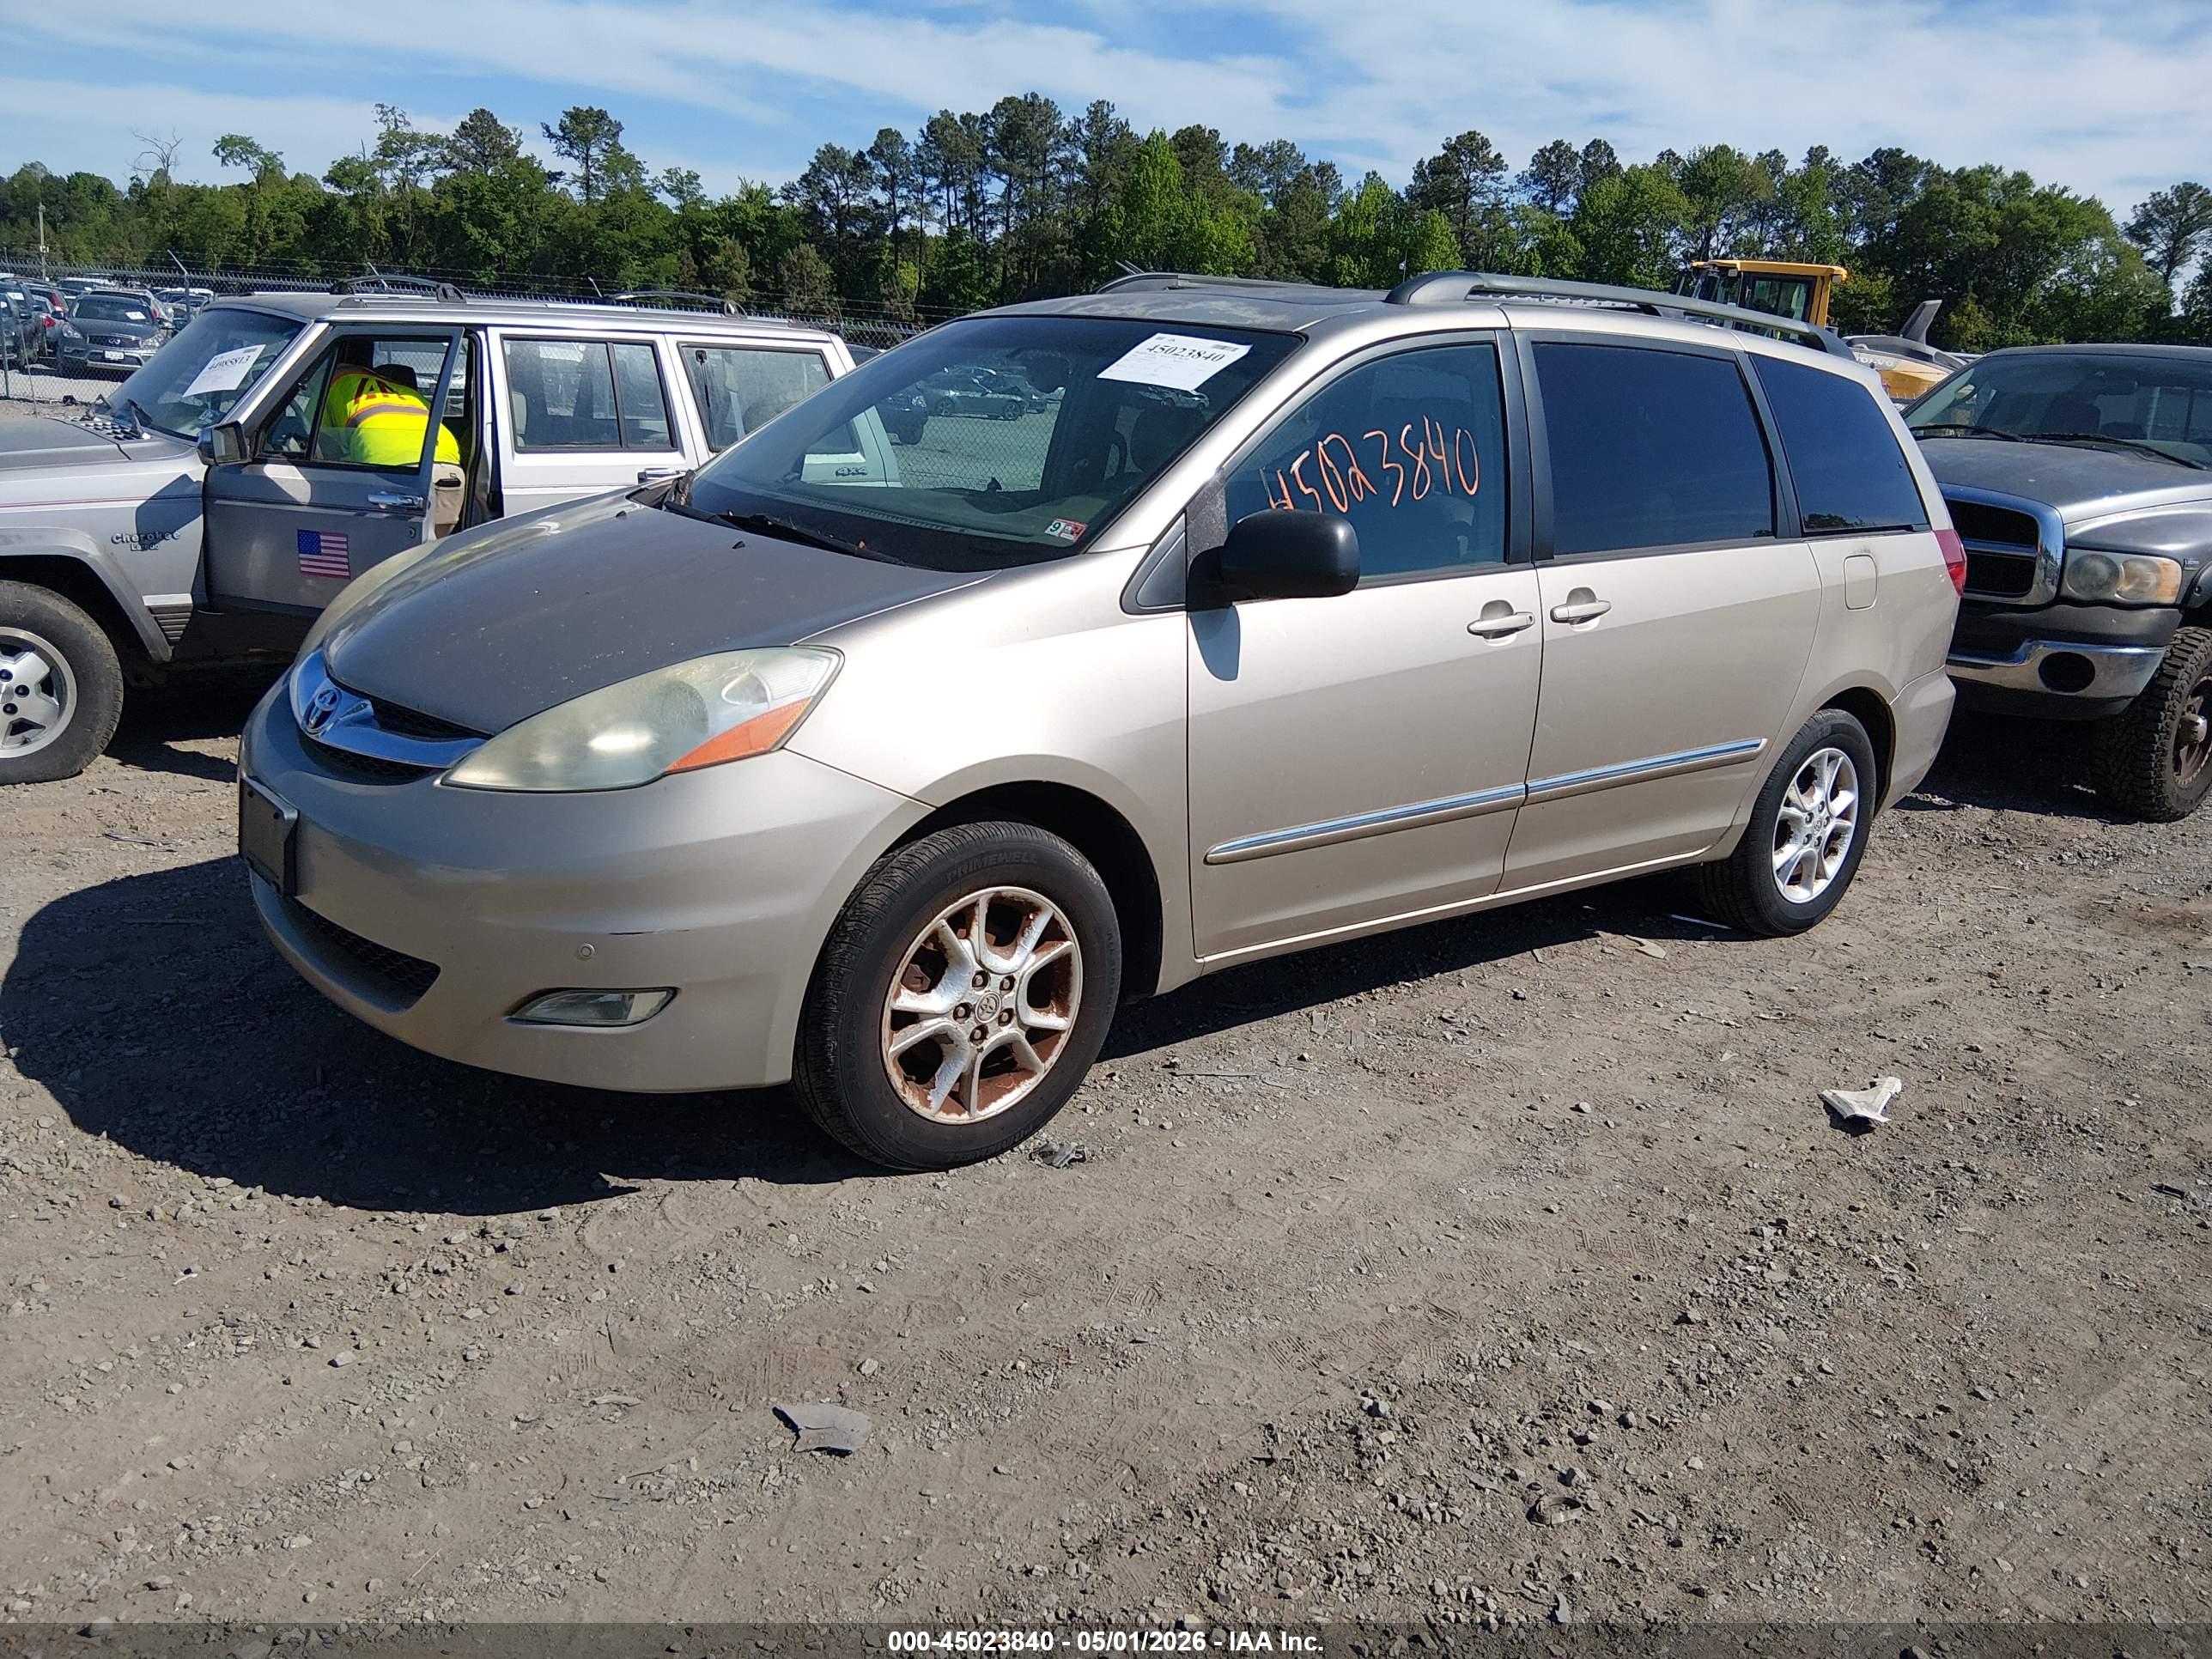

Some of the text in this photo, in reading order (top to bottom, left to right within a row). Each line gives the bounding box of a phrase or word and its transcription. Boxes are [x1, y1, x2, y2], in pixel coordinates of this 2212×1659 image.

[1146, 343, 1226, 362] 45023840
[1260, 415, 1479, 514] 45023840
[1049, 522, 1061, 532] 9
[111, 532, 180, 544] Cherokee
